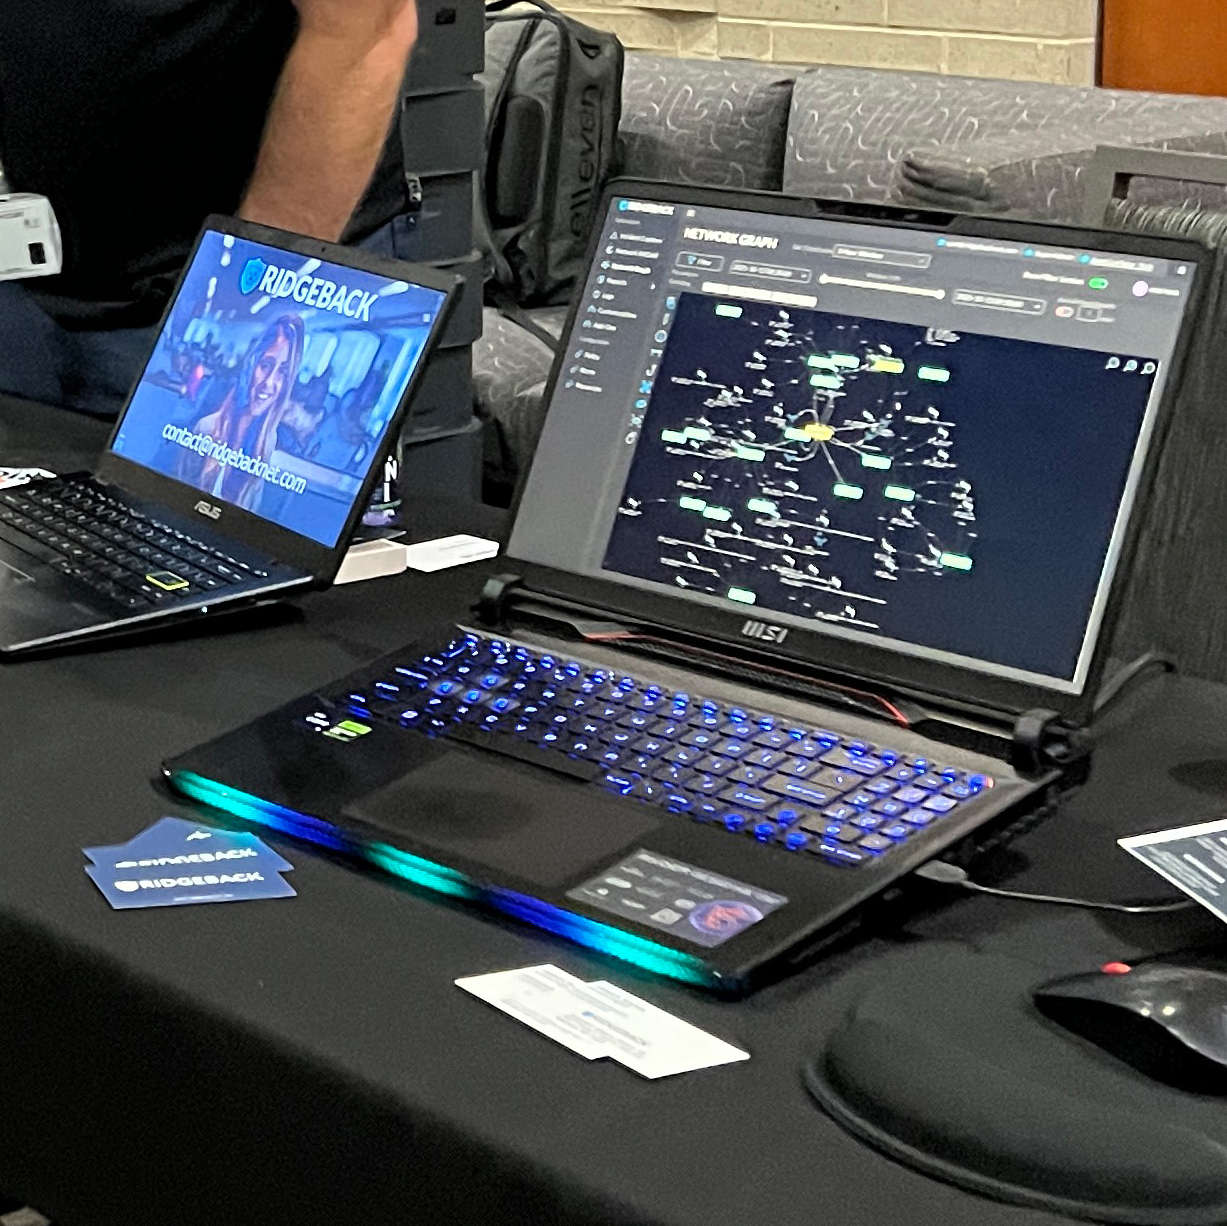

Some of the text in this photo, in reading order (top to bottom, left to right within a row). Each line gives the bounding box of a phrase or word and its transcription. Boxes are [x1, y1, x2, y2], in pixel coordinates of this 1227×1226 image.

[258, 265, 378, 321] RIDGEBACK
[194, 500, 222, 520] ASUS
[139, 871, 265, 890] RIDGEBACK
